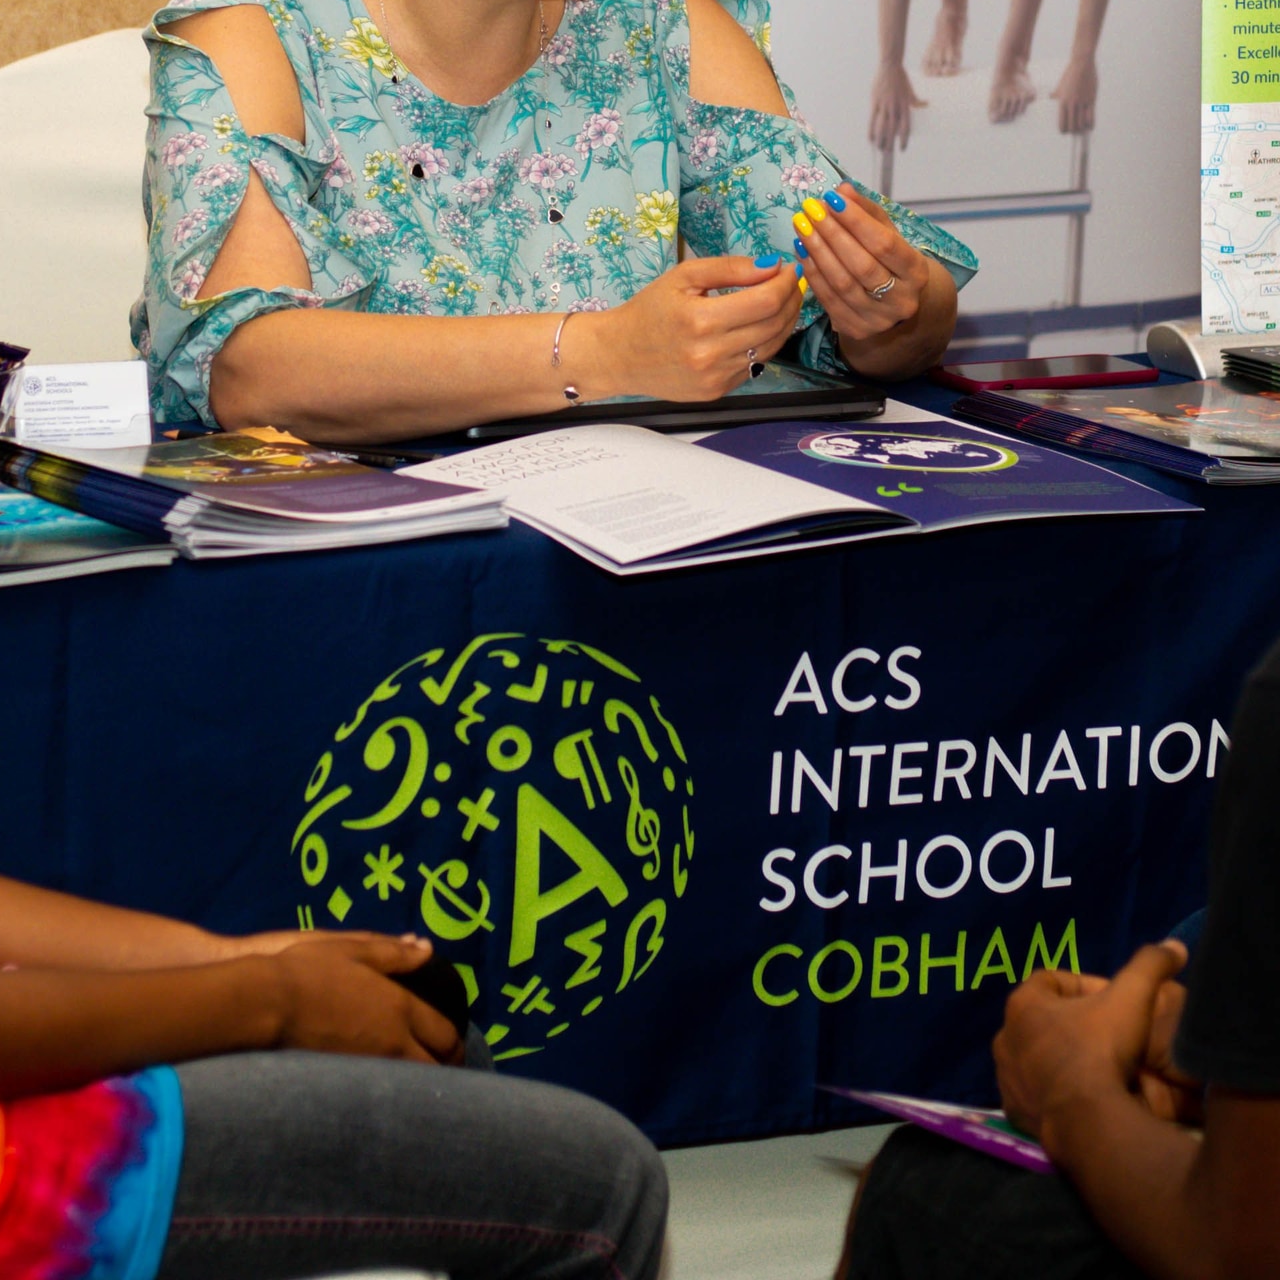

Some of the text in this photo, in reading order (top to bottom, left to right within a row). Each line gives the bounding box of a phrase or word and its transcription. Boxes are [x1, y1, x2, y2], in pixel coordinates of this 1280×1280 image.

[1232, 70, 1250, 84] 30
[774, 646, 923, 717] ACS
[766, 717, 1234, 818] INTERNATION
[759, 827, 1072, 912] SCHOOL
[752, 918, 1084, 1011] COBHAM
